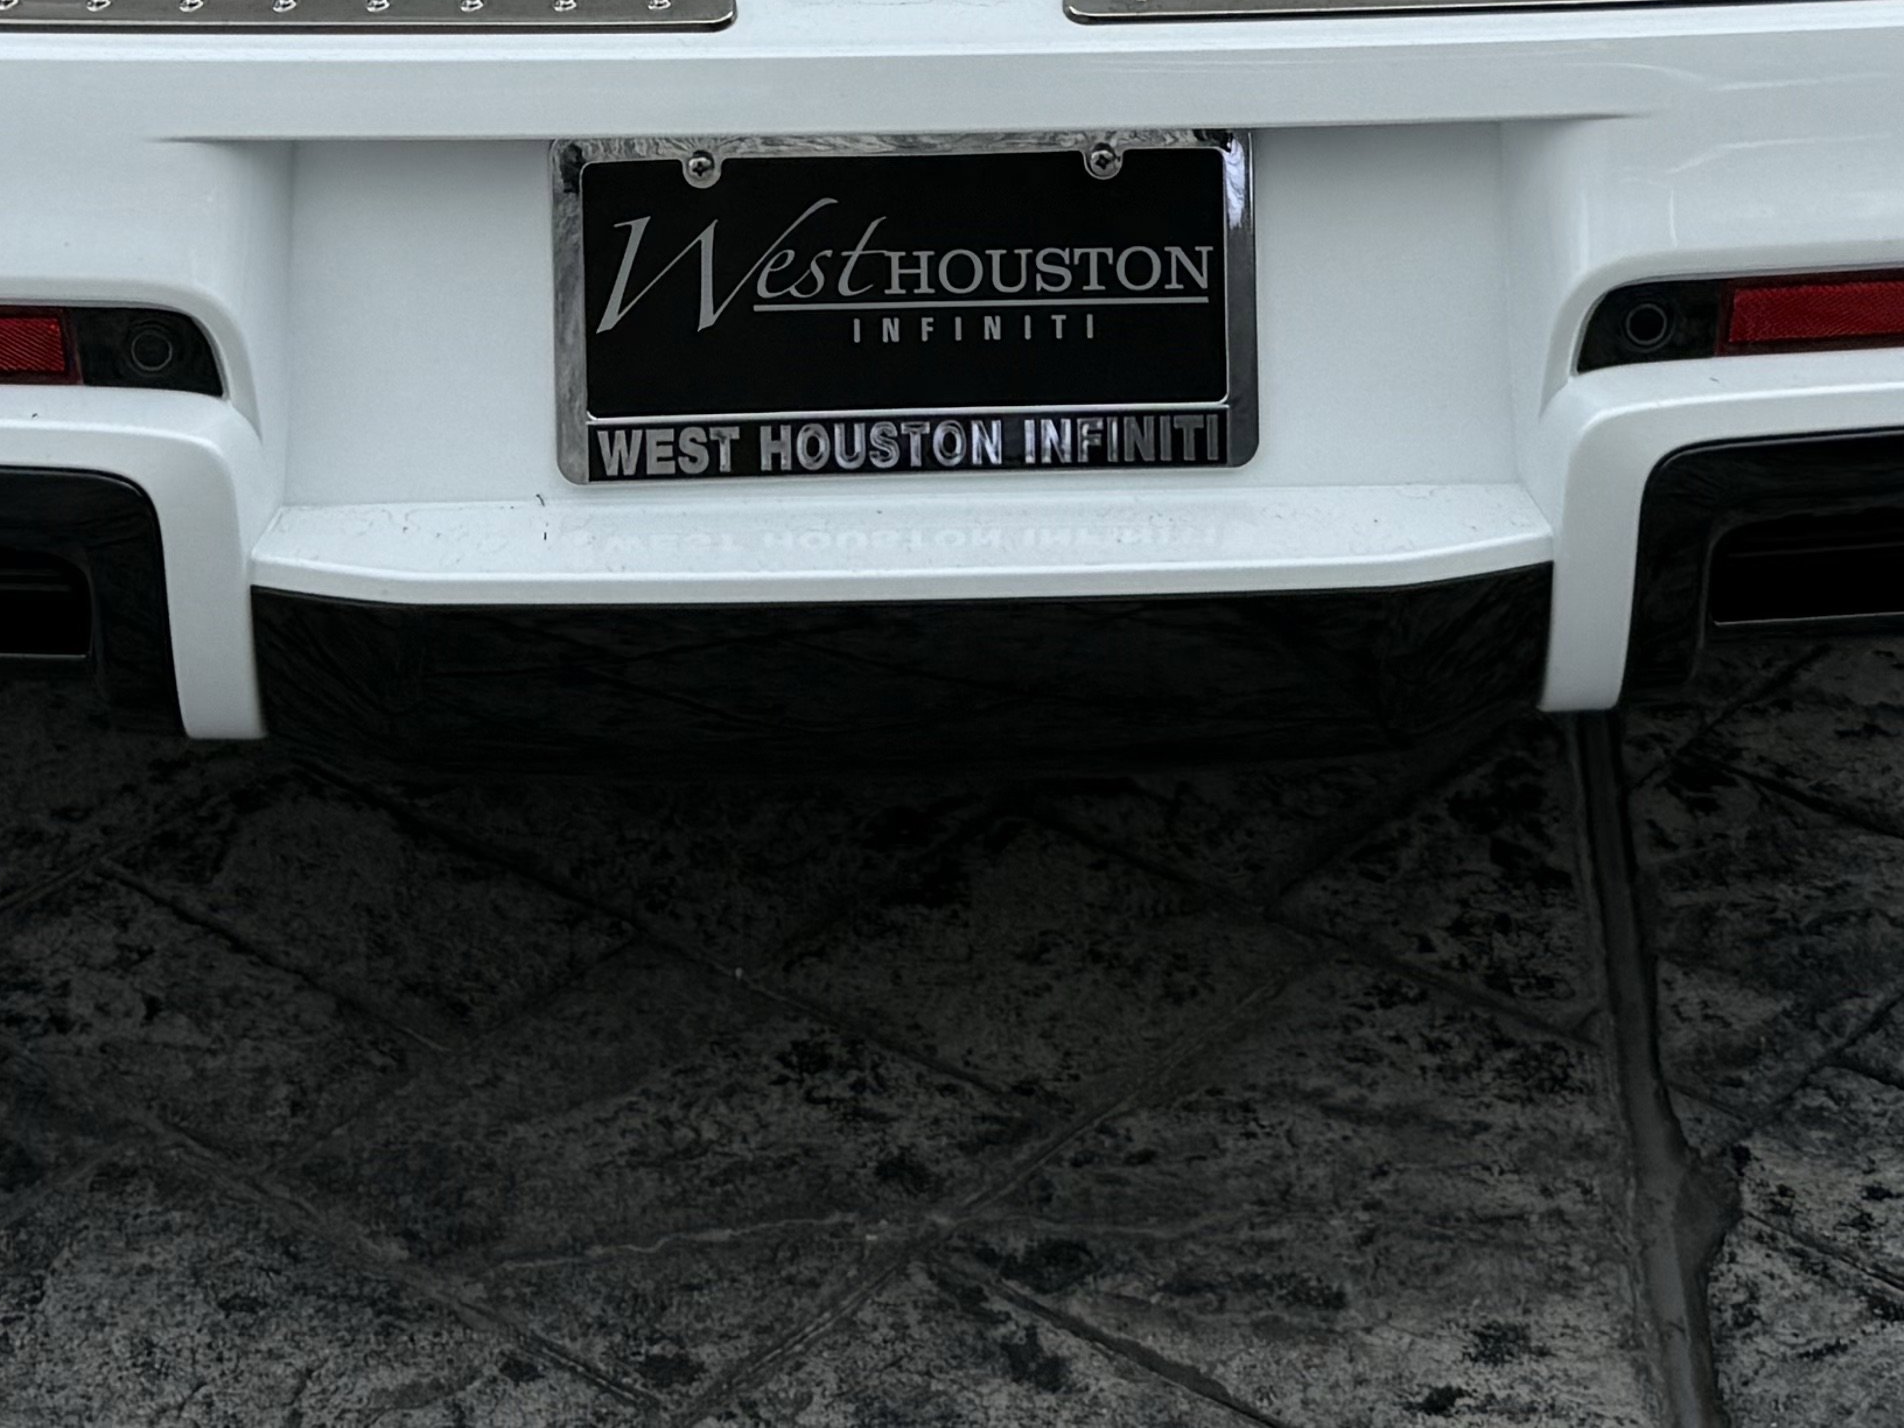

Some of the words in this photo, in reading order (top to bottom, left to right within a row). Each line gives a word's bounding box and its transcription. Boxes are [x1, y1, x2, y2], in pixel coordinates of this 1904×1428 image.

[595, 197, 887, 334] West
[884, 245, 1213, 294] HOUSTON
[853, 314, 1094, 343] INFINITI
[598, 427, 740, 476] WEST
[760, 418, 1003, 472] HOUSTON
[1023, 413, 1219, 465] INFINITI
